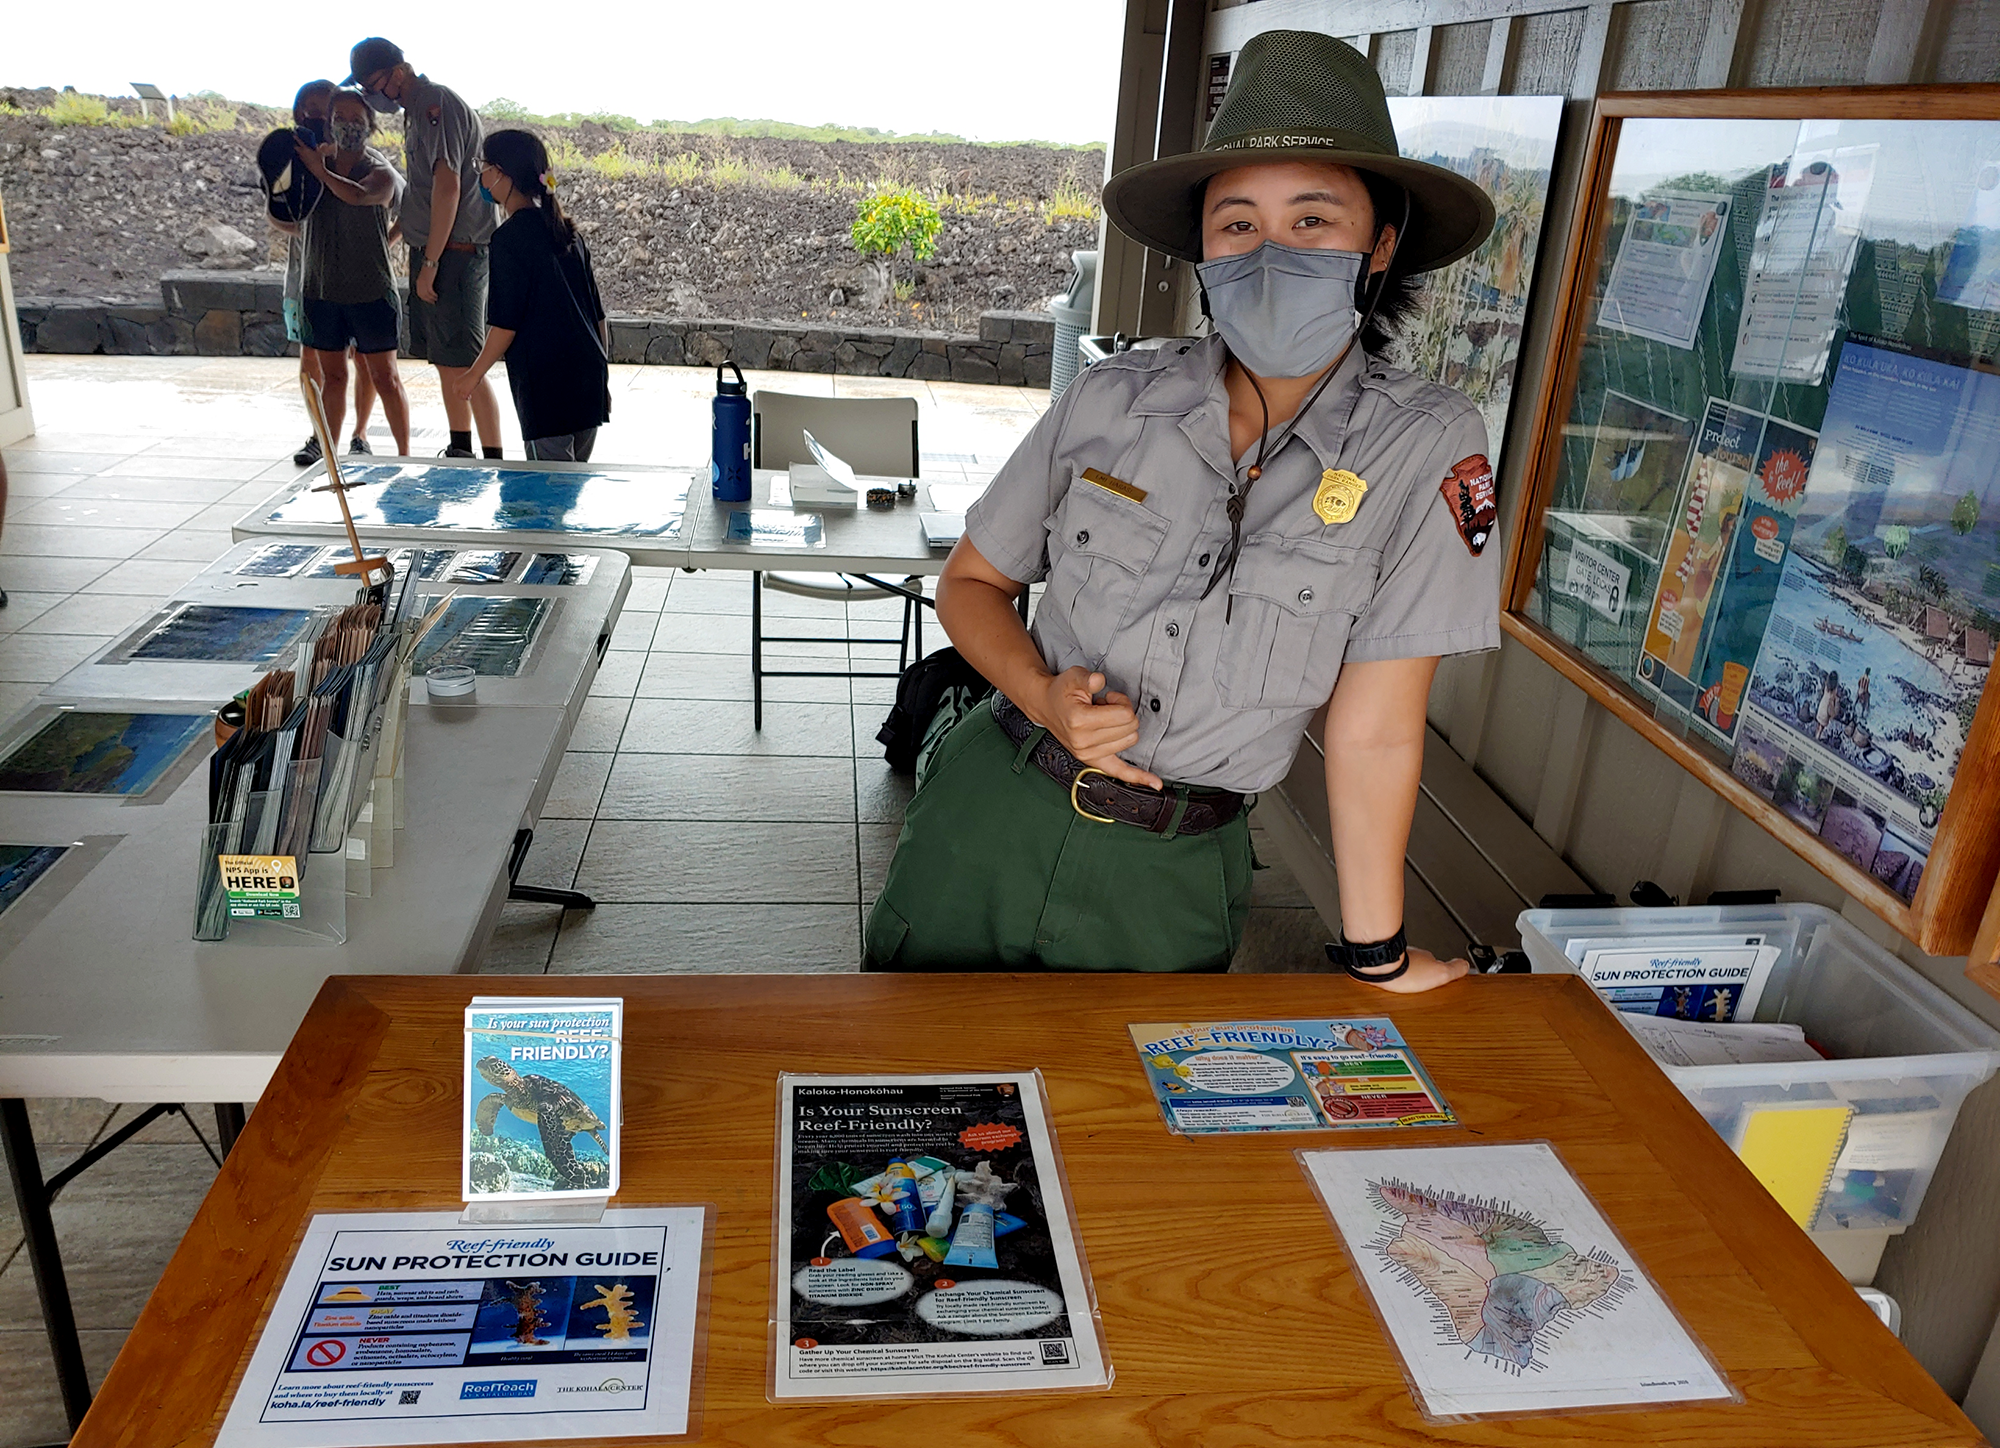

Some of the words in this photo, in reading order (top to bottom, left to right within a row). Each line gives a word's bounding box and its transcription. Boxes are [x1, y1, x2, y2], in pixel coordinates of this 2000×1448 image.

[1250, 136, 1280, 148] PARK
[1282, 136, 1334, 148] SERVICE
[1775, 456, 1790, 475] the
[1776, 472, 1800, 496] Reef!
[1575, 550, 1597, 569] VISITOR
[1597, 563, 1620, 583] CENTER
[1576, 566, 1592, 581] GATE
[1593, 575, 1611, 594] LOCKS
[227, 877, 277, 888] HERE
[1650, 957, 1702, 968] Reef-friendly
[1593, 971, 1621, 981] SUN
[1623, 968, 1706, 980] PROTECTION
[1709, 967, 1748, 978] GUIDE
[487, 1018, 498, 1029] Is
[500, 1020, 527, 1031] your
[528, 1020, 549, 1028] sun
[551, 1018, 609, 1031] protection
[1187, 1026, 1211, 1034] your
[1237, 1024, 1295, 1033] protection
[1144, 1031, 1337, 1056] REEF-FRIENDLY?
[511, 1044, 608, 1061] FRIENDLY?
[800, 1106, 814, 1116] Is
[820, 1106, 864, 1116] Your
[869, 1105, 962, 1116] Sunscreen
[799, 1120, 932, 1132] Reef-Friendly?
[447, 1238, 555, 1253] Reef-friendly
[328, 1256, 387, 1271] SUN
[392, 1253, 569, 1270] PROTECTION
[575, 1252, 658, 1266] GUIDE
[465, 1383, 534, 1393] ReefTeach
[271, 1399, 386, 1409] koha.la/reef-friendly
